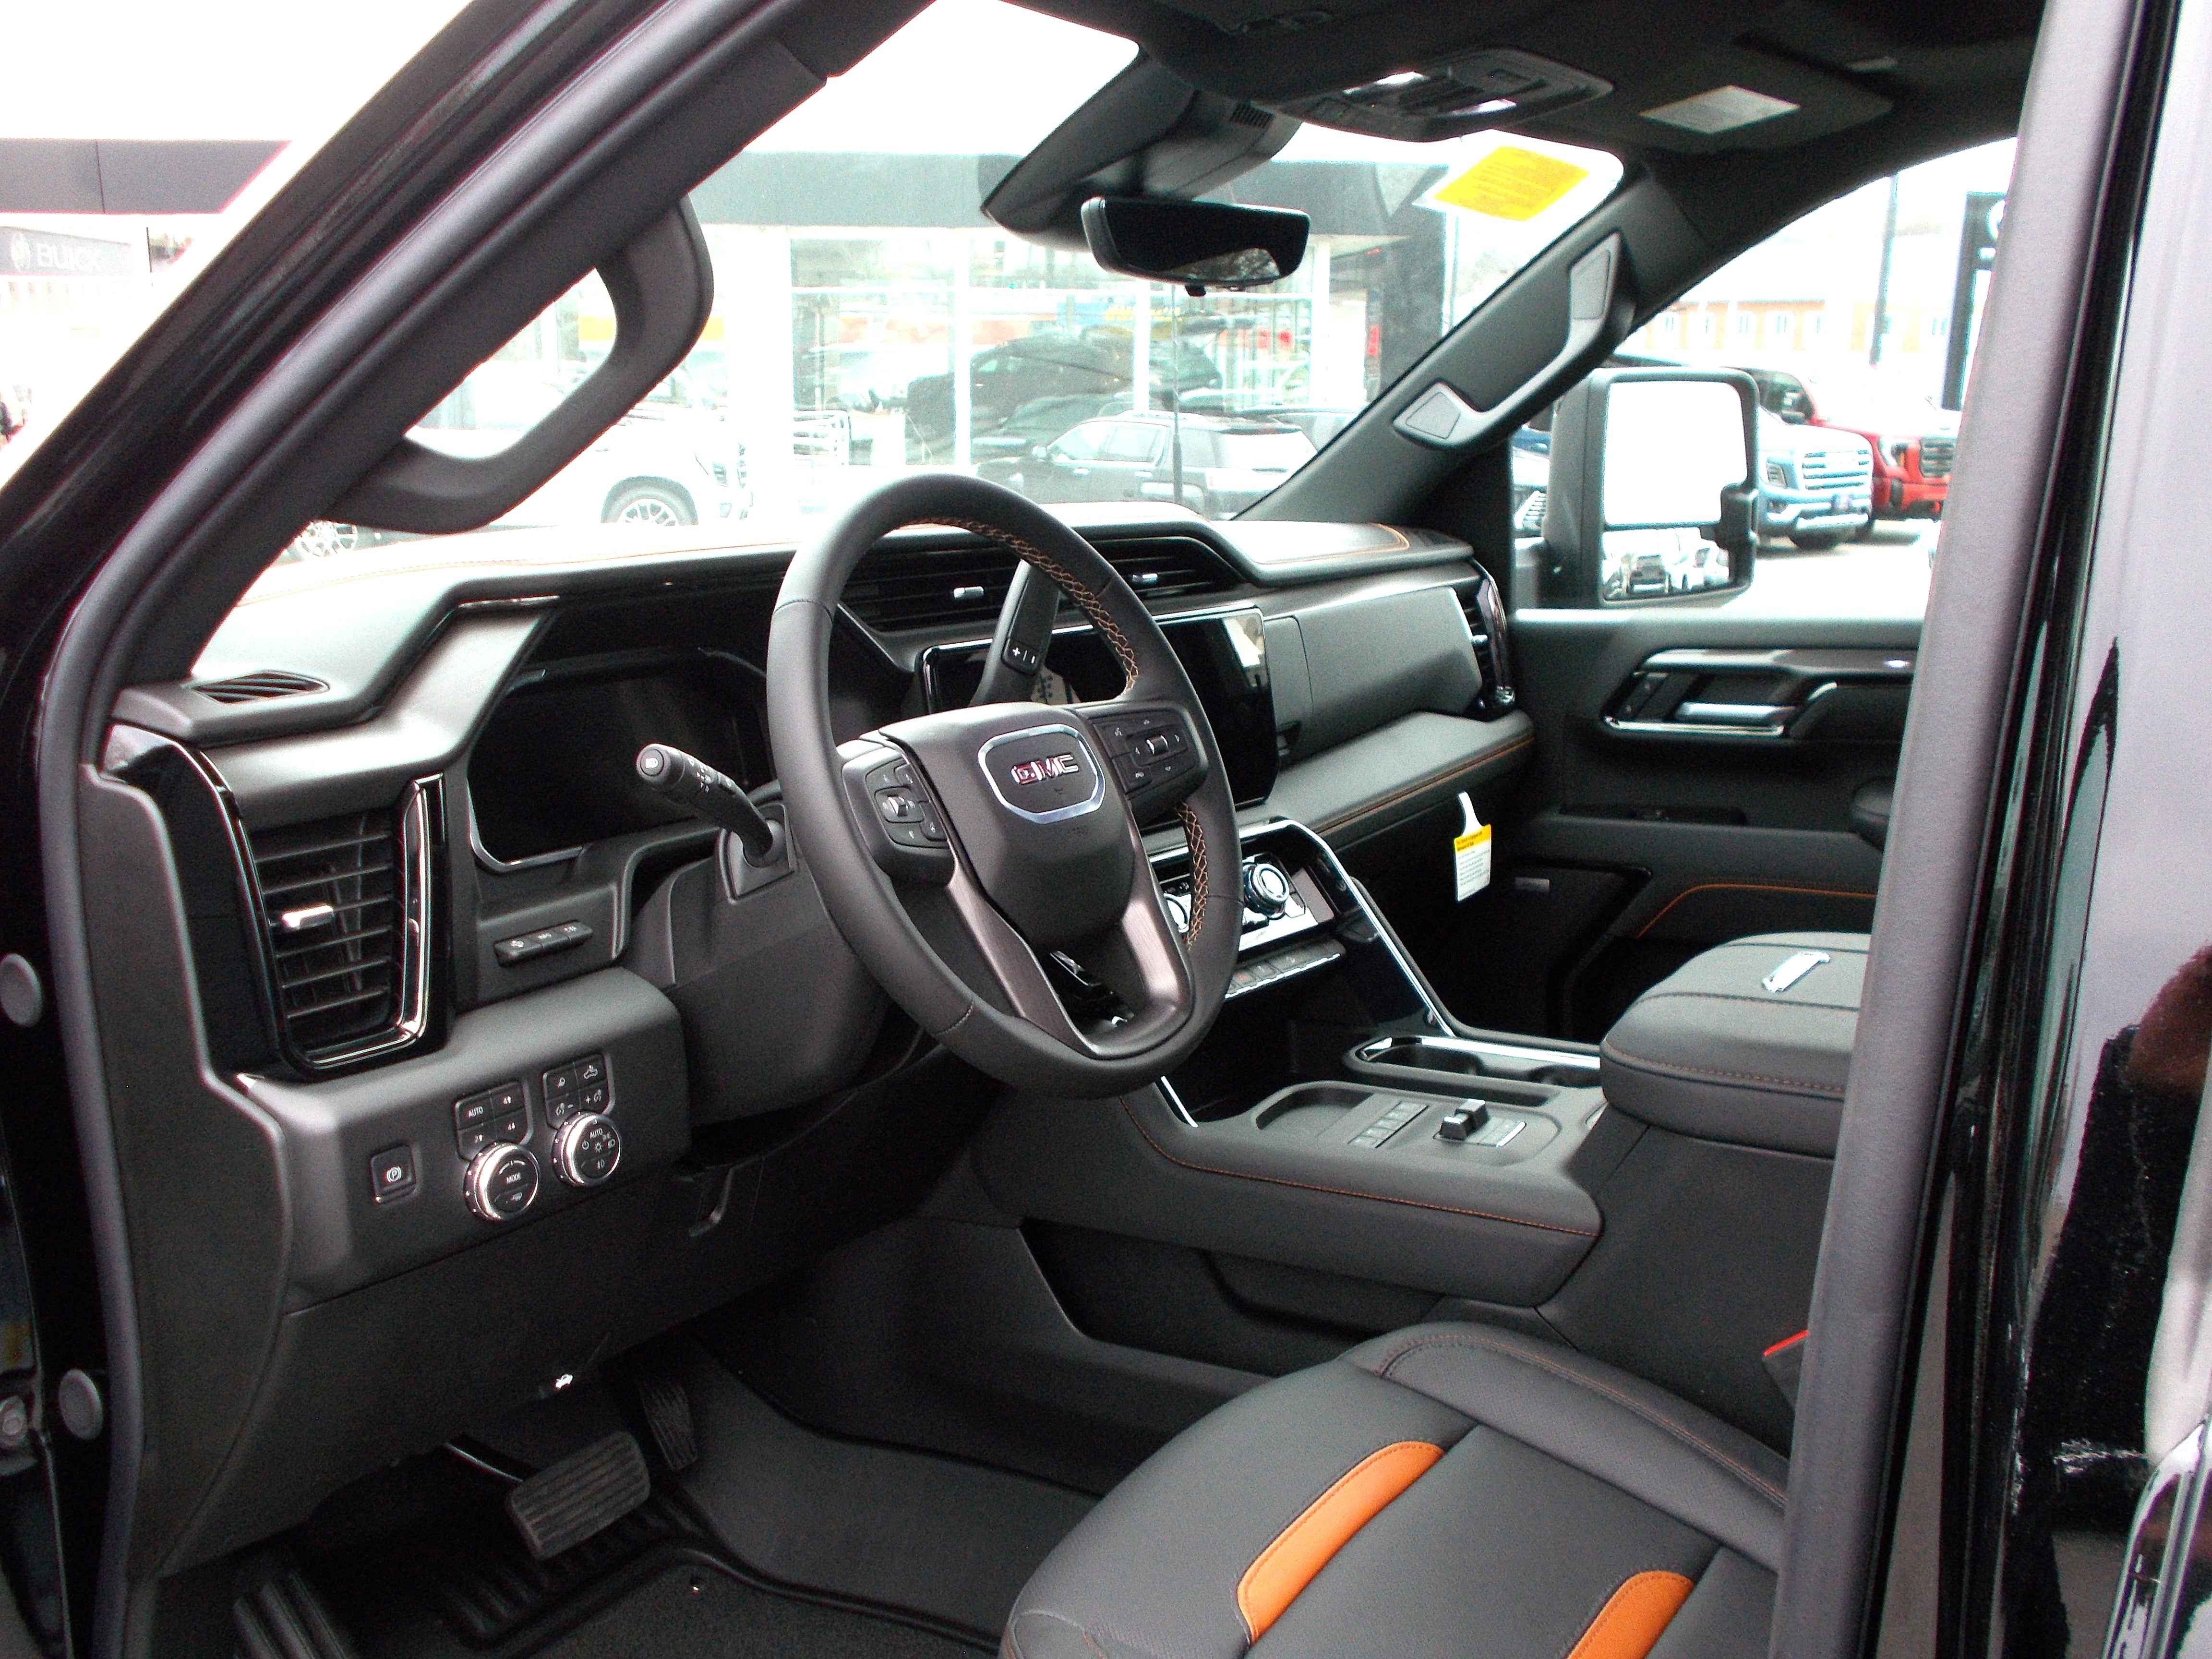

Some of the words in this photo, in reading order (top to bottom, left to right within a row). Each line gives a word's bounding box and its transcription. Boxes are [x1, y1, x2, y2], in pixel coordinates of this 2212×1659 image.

[37, 243, 101, 272] BUICK
[1011, 755, 1079, 784] GMC
[469, 1106, 484, 1118] AUTO
[590, 1128, 603, 1139] AUTO
